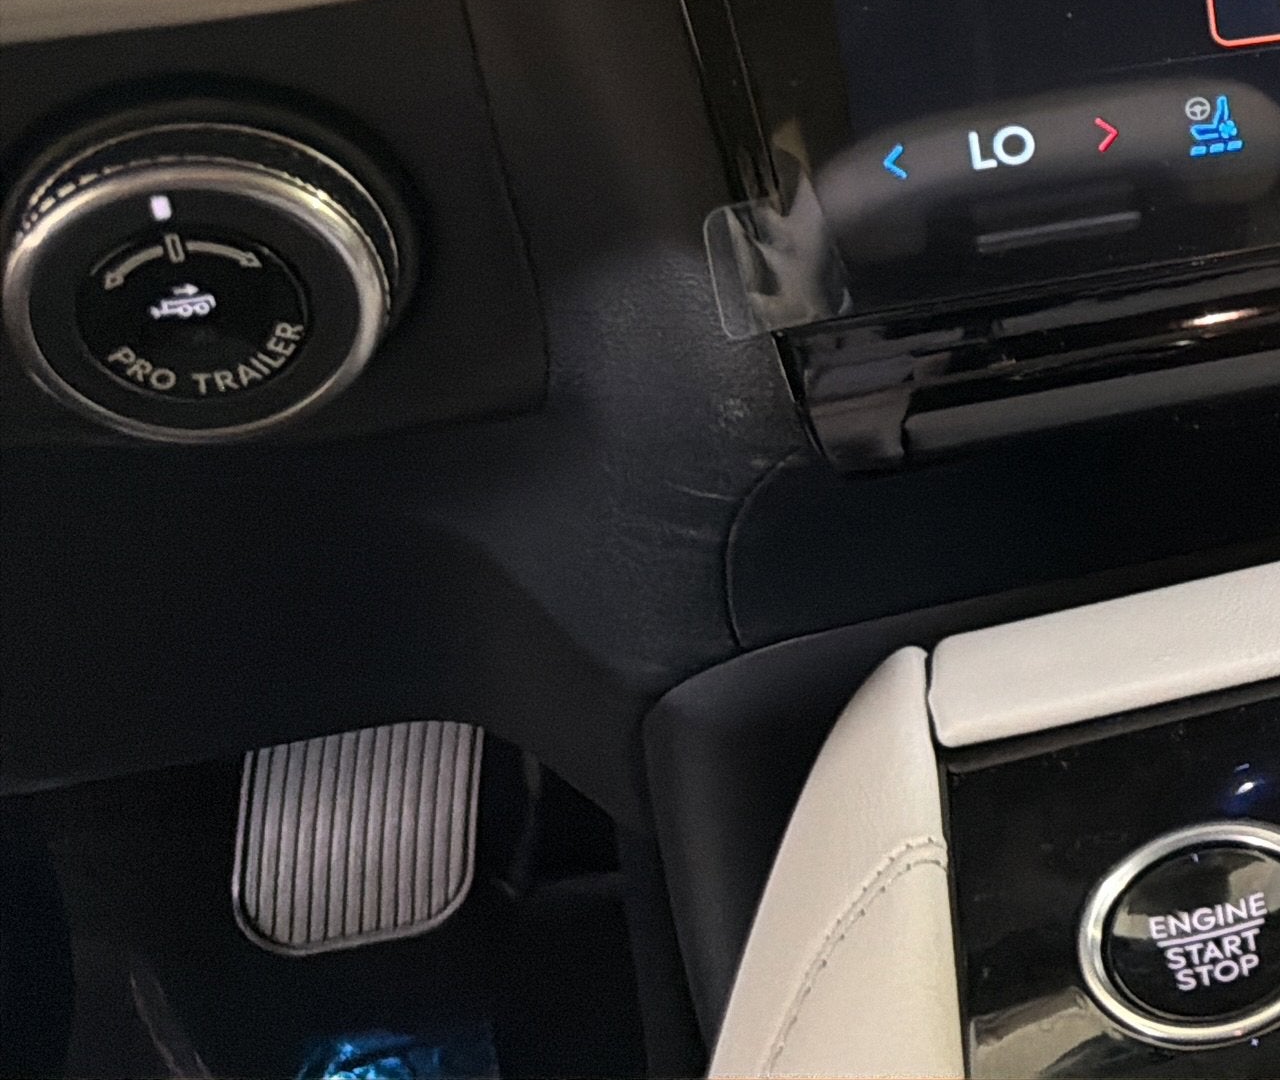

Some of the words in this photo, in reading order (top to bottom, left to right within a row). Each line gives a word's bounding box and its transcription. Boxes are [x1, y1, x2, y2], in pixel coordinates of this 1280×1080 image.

[968, 126, 1036, 172] LO
[107, 346, 178, 391] PRO
[191, 321, 304, 395] TRAILER
[1148, 891, 1268, 940] ENGINE
[1164, 928, 1260, 970] START
[1175, 953, 1260, 992] STOP
